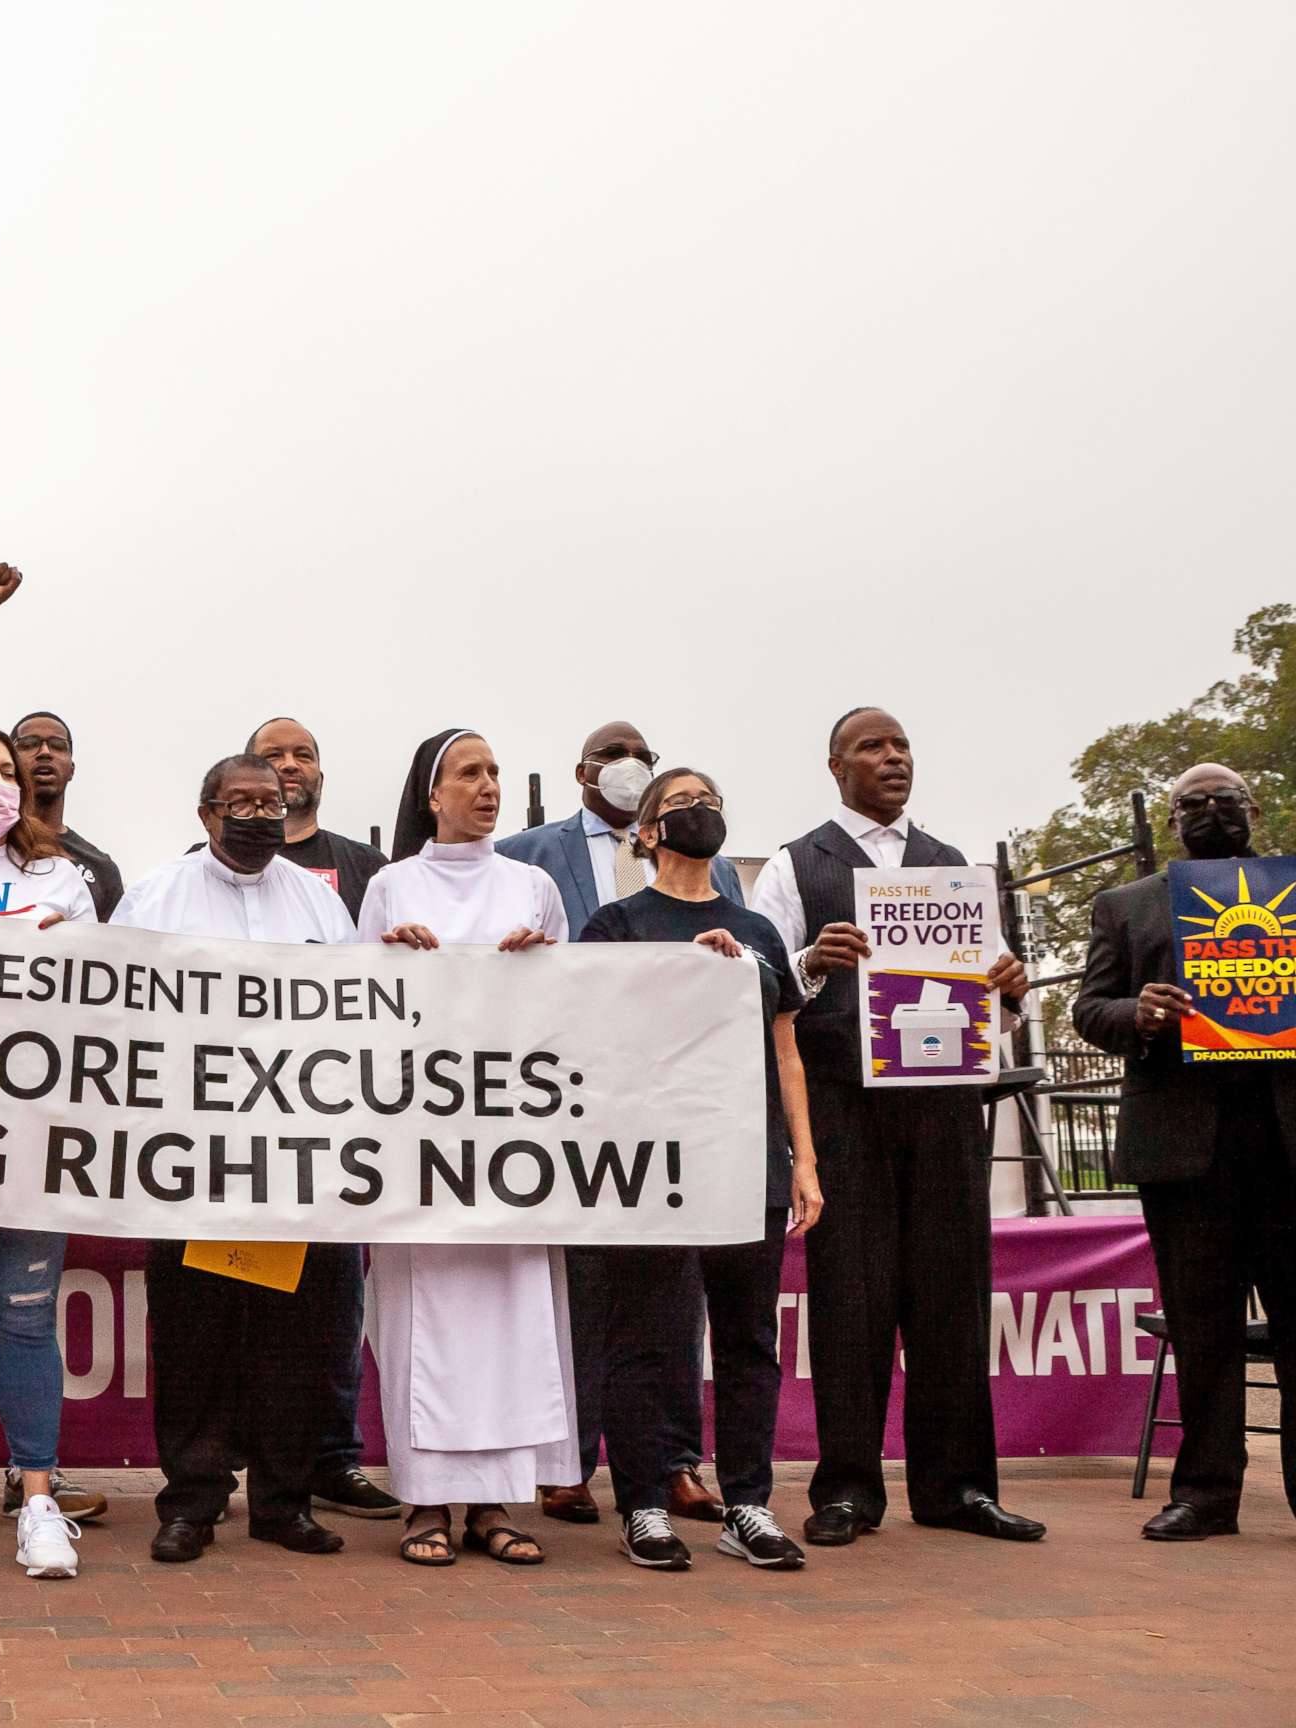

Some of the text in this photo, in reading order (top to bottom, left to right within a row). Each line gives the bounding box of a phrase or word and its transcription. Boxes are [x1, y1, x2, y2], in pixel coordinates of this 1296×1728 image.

[869, 885, 932, 897] PASS THE
[870, 902, 983, 922] FREEDOM
[871, 924, 983, 946] TO VOTE
[949, 950, 982, 963] ACT
[1184, 939, 1256, 960] PASS
[1184, 957, 1296, 979] FREEDO
[1192, 978, 1232, 998] TO
[238, 975, 422, 1028] BIDEN,
[1226, 996, 1284, 1015] ACT
[193, 1044, 585, 1118] EXCUSES:
[44, 1125, 383, 1207] RIGHTS
[419, 1139, 684, 1209] NOW!
